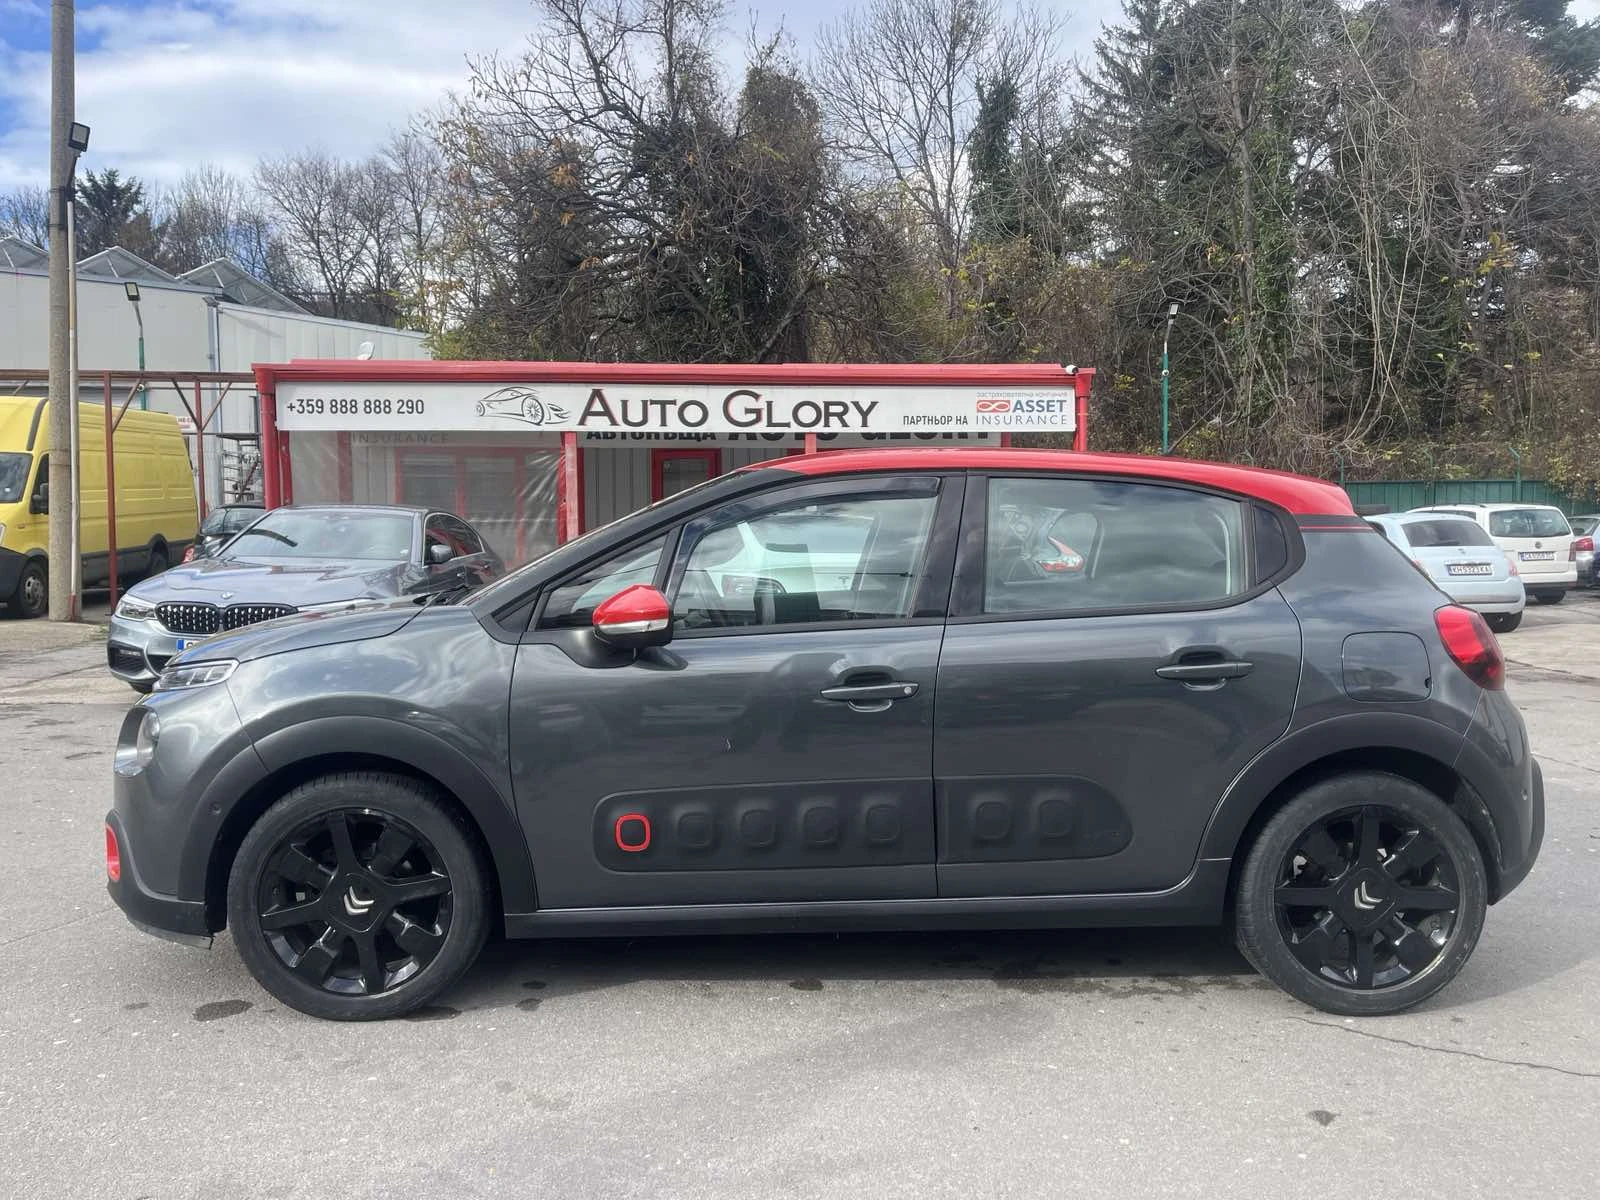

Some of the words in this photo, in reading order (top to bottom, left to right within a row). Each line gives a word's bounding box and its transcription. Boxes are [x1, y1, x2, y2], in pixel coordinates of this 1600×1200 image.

[287, 398, 325, 414] +359
[329, 398, 359, 414] 888
[363, 398, 392, 414] 888
[396, 398, 425, 414] 290
[1012, 399, 1067, 413] ASSET
[903, 415, 953, 426] ПАРТНЬОР
[955, 415, 968, 426] НА
[976, 414, 1068, 425] INSURANCE
